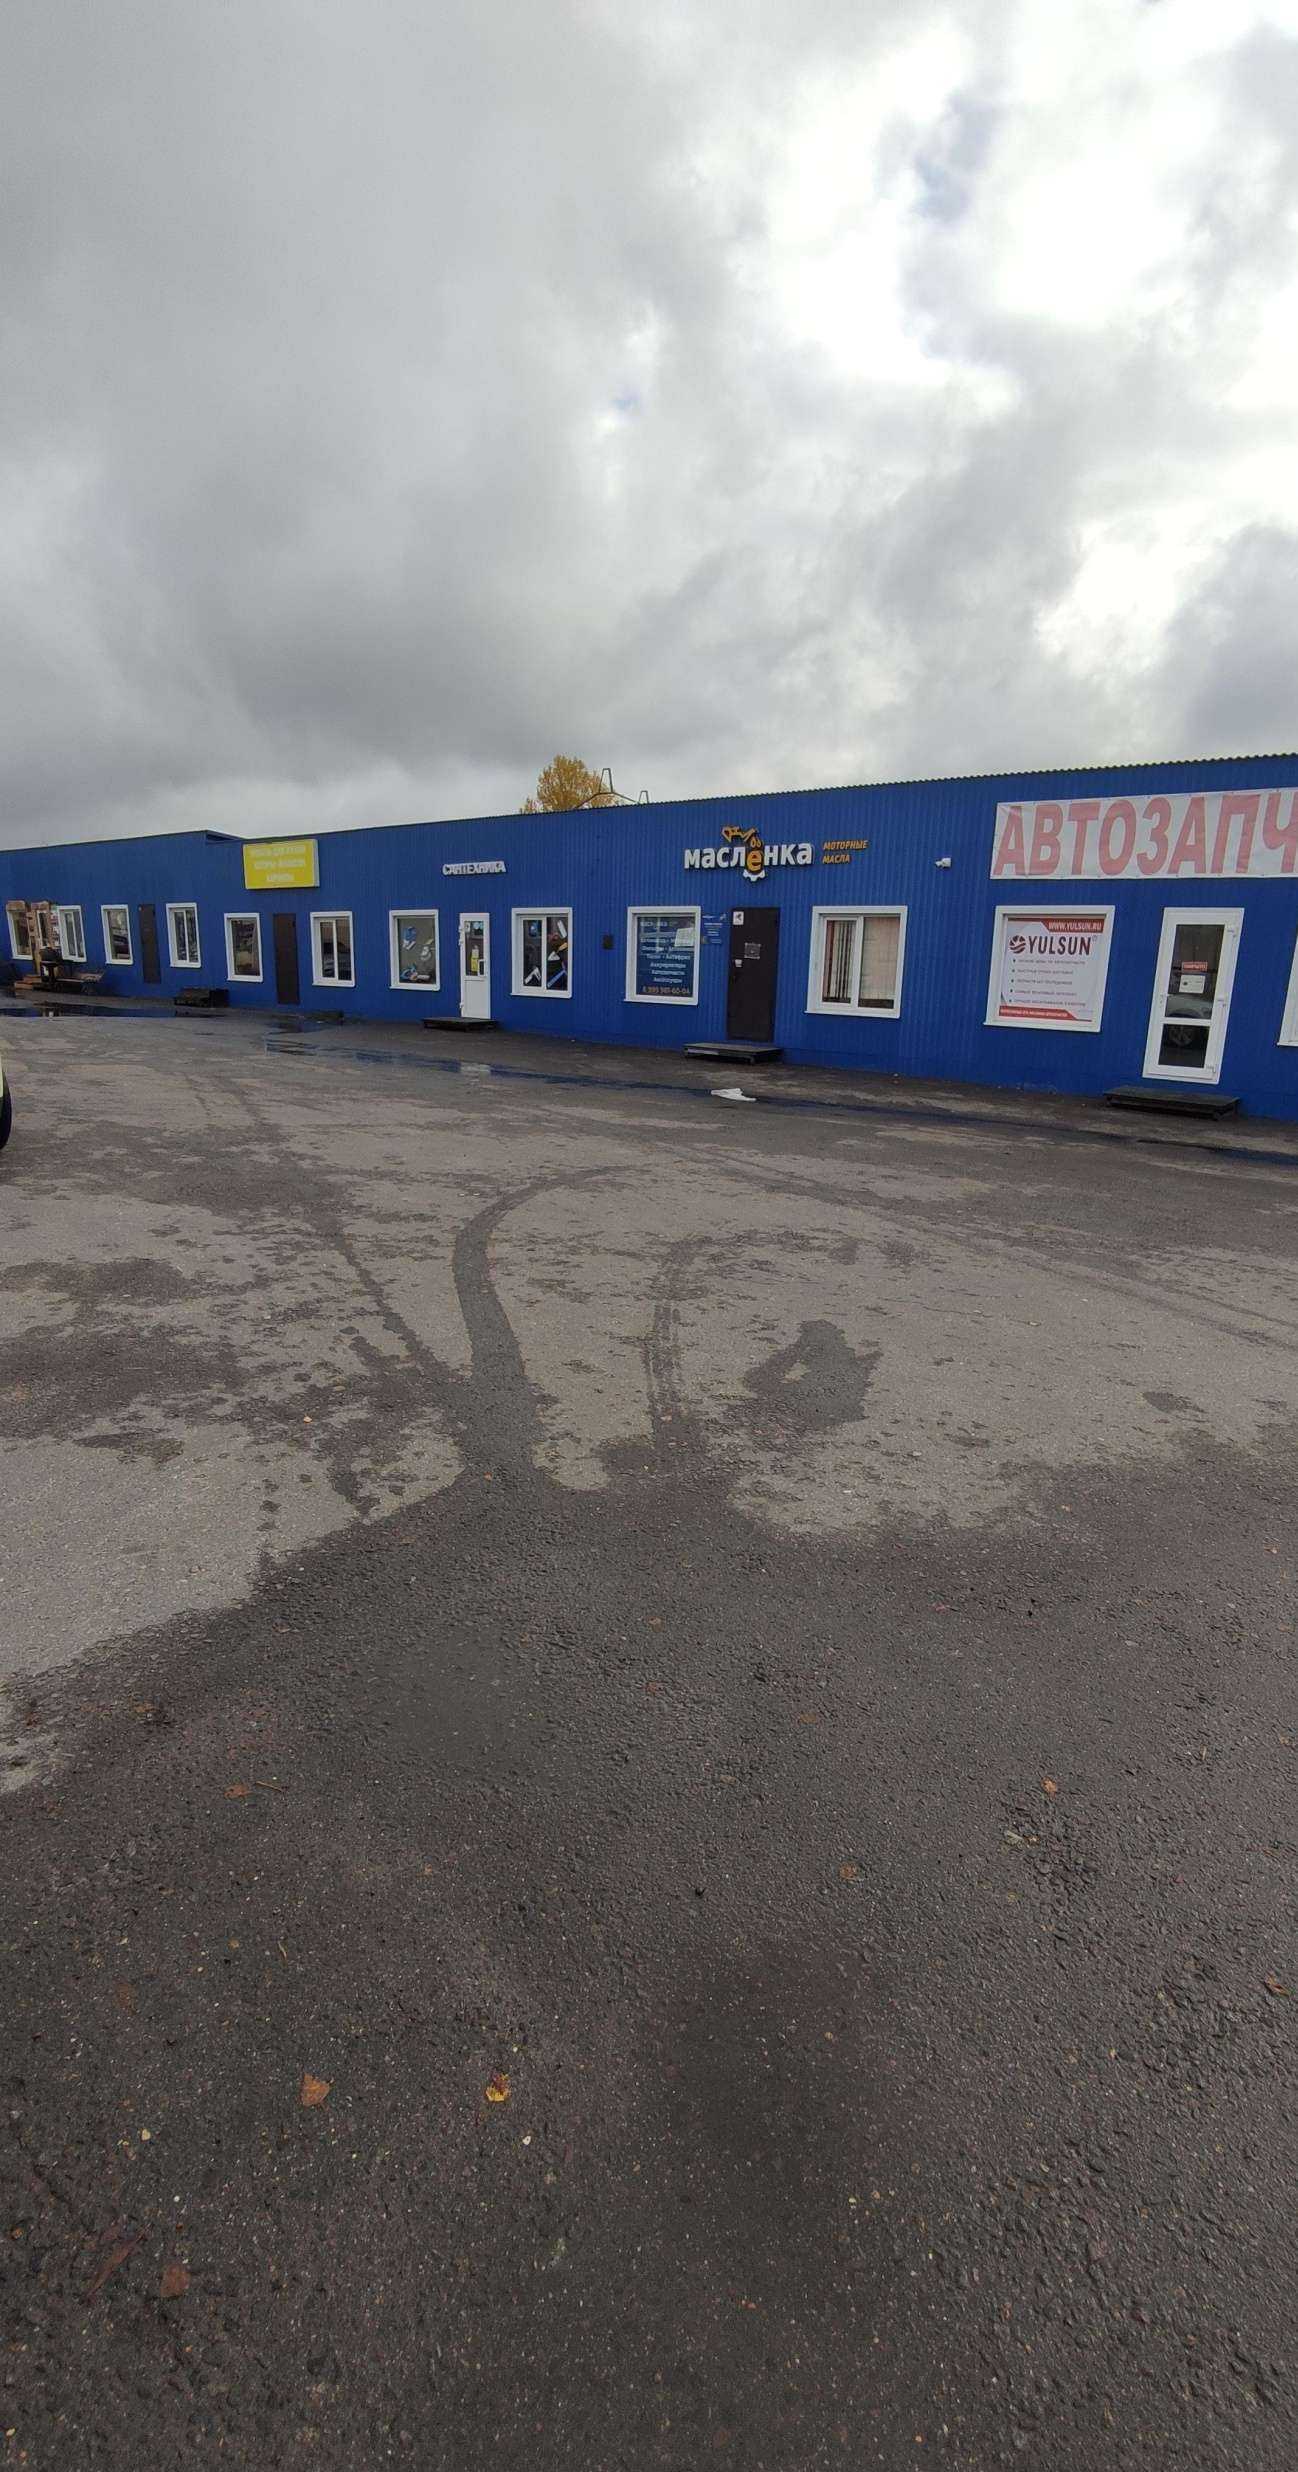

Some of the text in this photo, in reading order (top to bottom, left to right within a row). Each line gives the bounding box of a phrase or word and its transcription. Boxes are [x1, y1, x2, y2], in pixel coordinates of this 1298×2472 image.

[823, 839, 868, 850] МОТОРНЫЕ
[822, 854, 850, 864] МАСЛА
[442, 860, 507, 876] САНТЕХНИКА
[1048, 921, 1102, 931] WWW.YULSUN.RU
[1028, 935, 1092, 956] YULSUN
